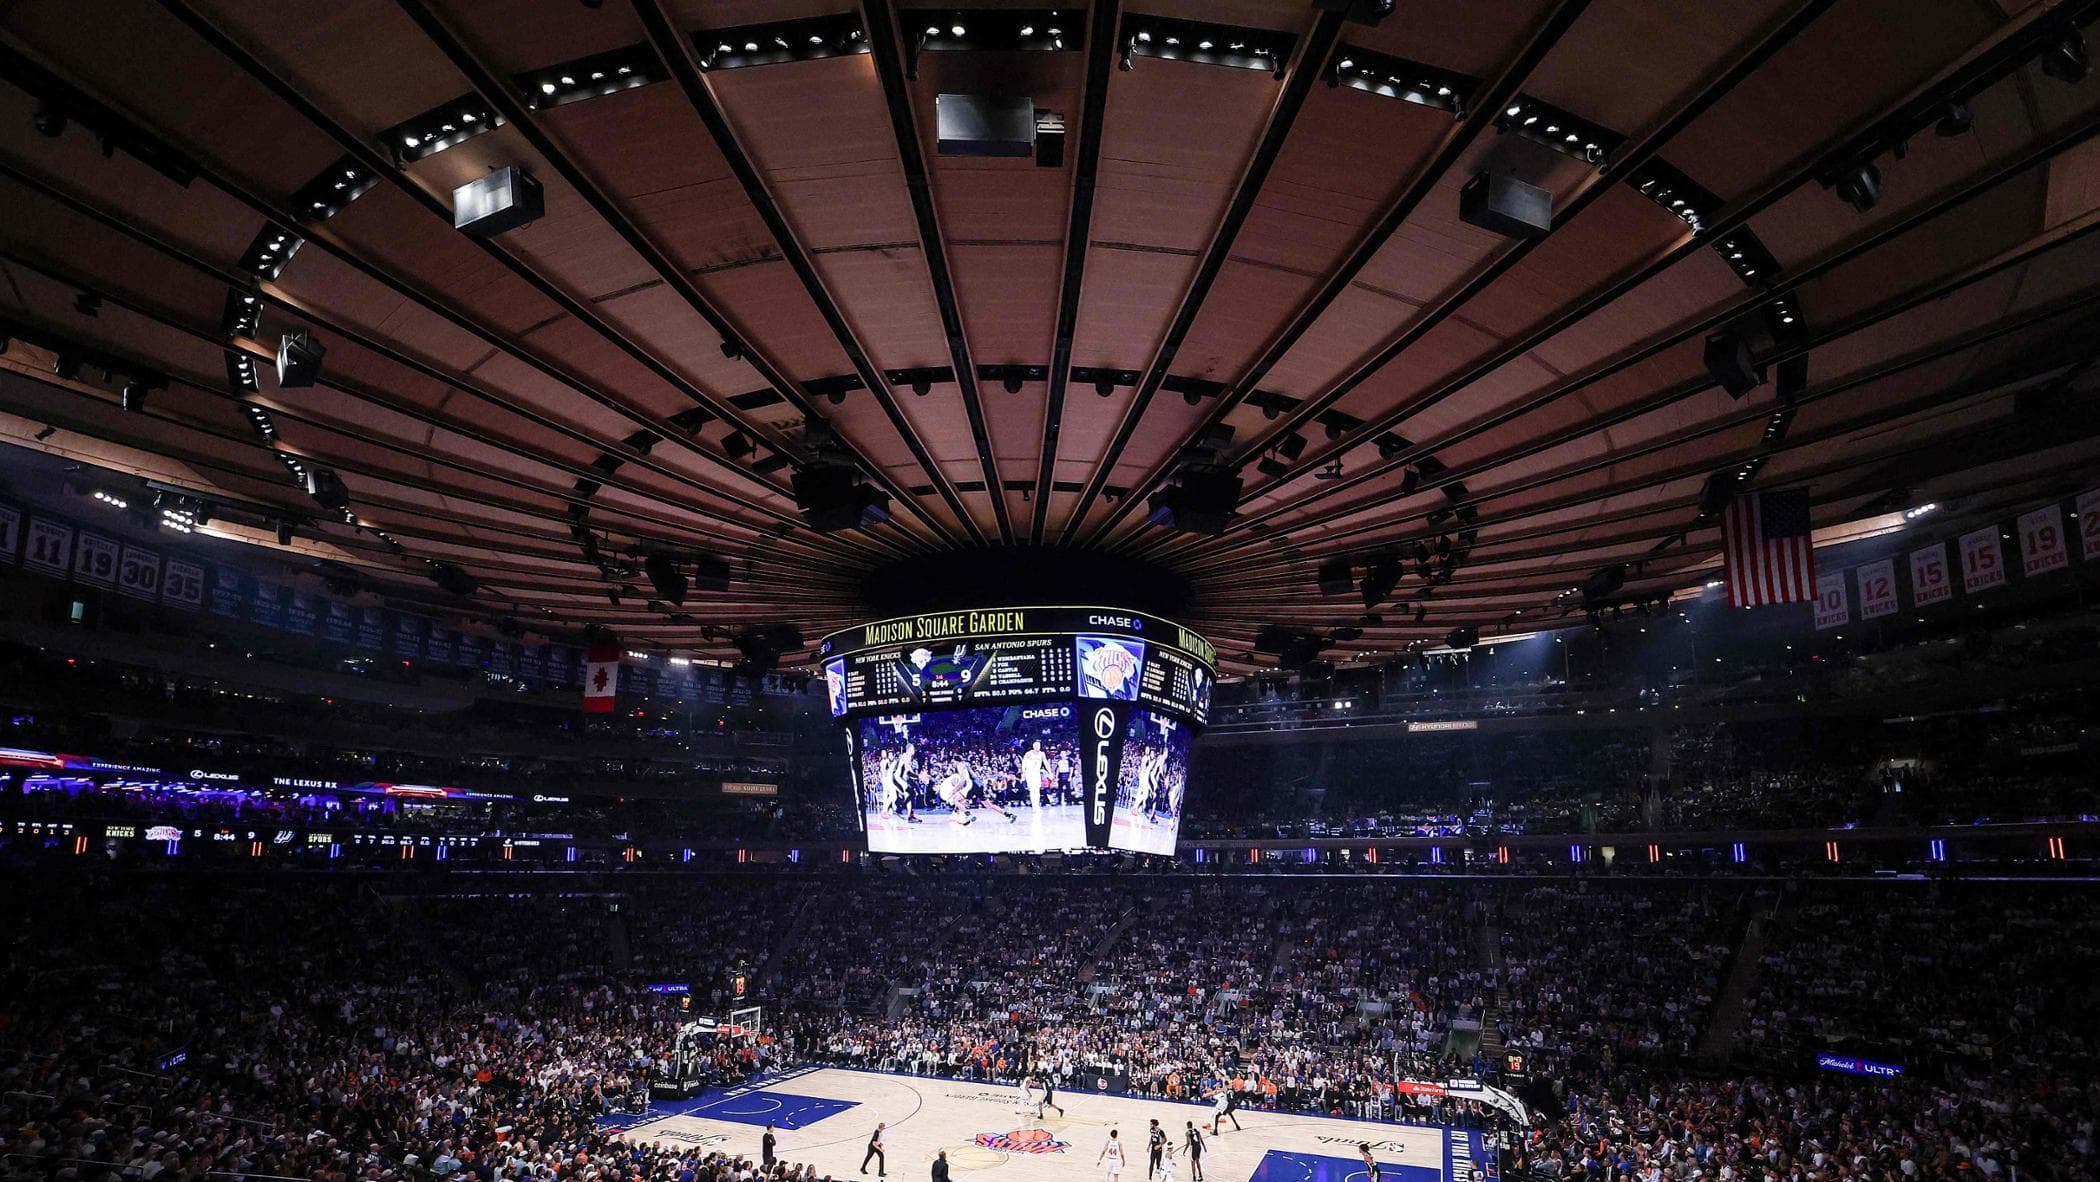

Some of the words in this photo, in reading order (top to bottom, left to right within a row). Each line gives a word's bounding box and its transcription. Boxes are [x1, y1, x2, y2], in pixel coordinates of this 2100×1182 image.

[33, 534, 61, 565] 11
[2028, 526, 2057, 555] 19
[82, 548, 112, 578] 19
[1968, 545, 1995, 573] 15
[123, 560, 154, 589] 30
[1918, 561, 1942, 588] 15
[165, 573, 199, 601] 35
[1865, 577, 1889, 601] 12
[1820, 590, 1841, 612] 10
[865, 621, 913, 646] MADISON
[916, 615, 965, 638] SQUARE
[969, 611, 1024, 633] GARDEN
[1089, 615, 1131, 628] CHASE
[975, 643, 989, 651] SAN
[991, 640, 1025, 650] ANTONIO
[1026, 639, 1052, 647] SPURS
[1178, 627, 1205, 659] MADISON
[912, 673, 921, 686] 5
[960, 669, 971, 682] 9
[931, 680, 949, 688] 8:44
[1023, 708, 1059, 719] CHASE
[92, 762, 131, 770] EXPERIENCE
[273, 777, 291, 785] THE
[293, 779, 322, 788] LEXUS
[325, 780, 337, 789] RX
[1093, 741, 1110, 826] LEXUS
[106, 830, 135, 838] KNICKS
[213, 833, 235, 841] 8:44
[247, 831, 255, 839] 9
[1820, 1058, 1855, 1070] Michelob
[1109, 1148, 1117, 1156] 44
